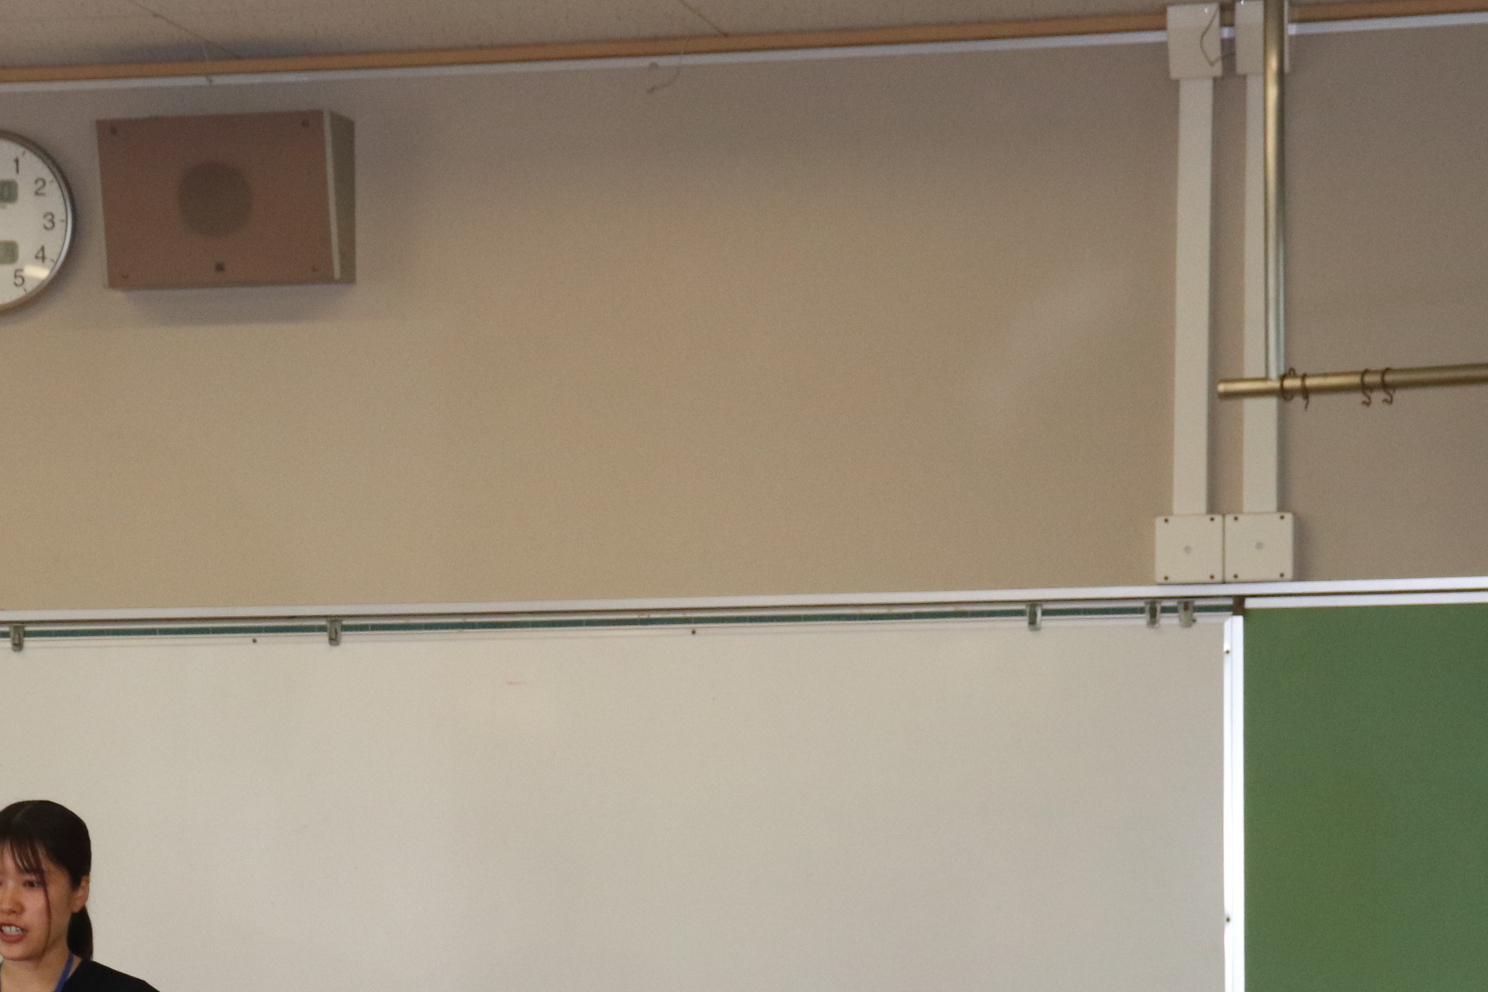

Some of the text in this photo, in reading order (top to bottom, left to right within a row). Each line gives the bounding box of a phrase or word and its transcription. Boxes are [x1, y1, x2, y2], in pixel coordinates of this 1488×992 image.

[14, 157, 20, 174] 1
[34, 178, 46, 196] 2
[43, 212, 55, 231] 3
[34, 246, 47, 263] 4
[13, 269, 25, 287] 5
